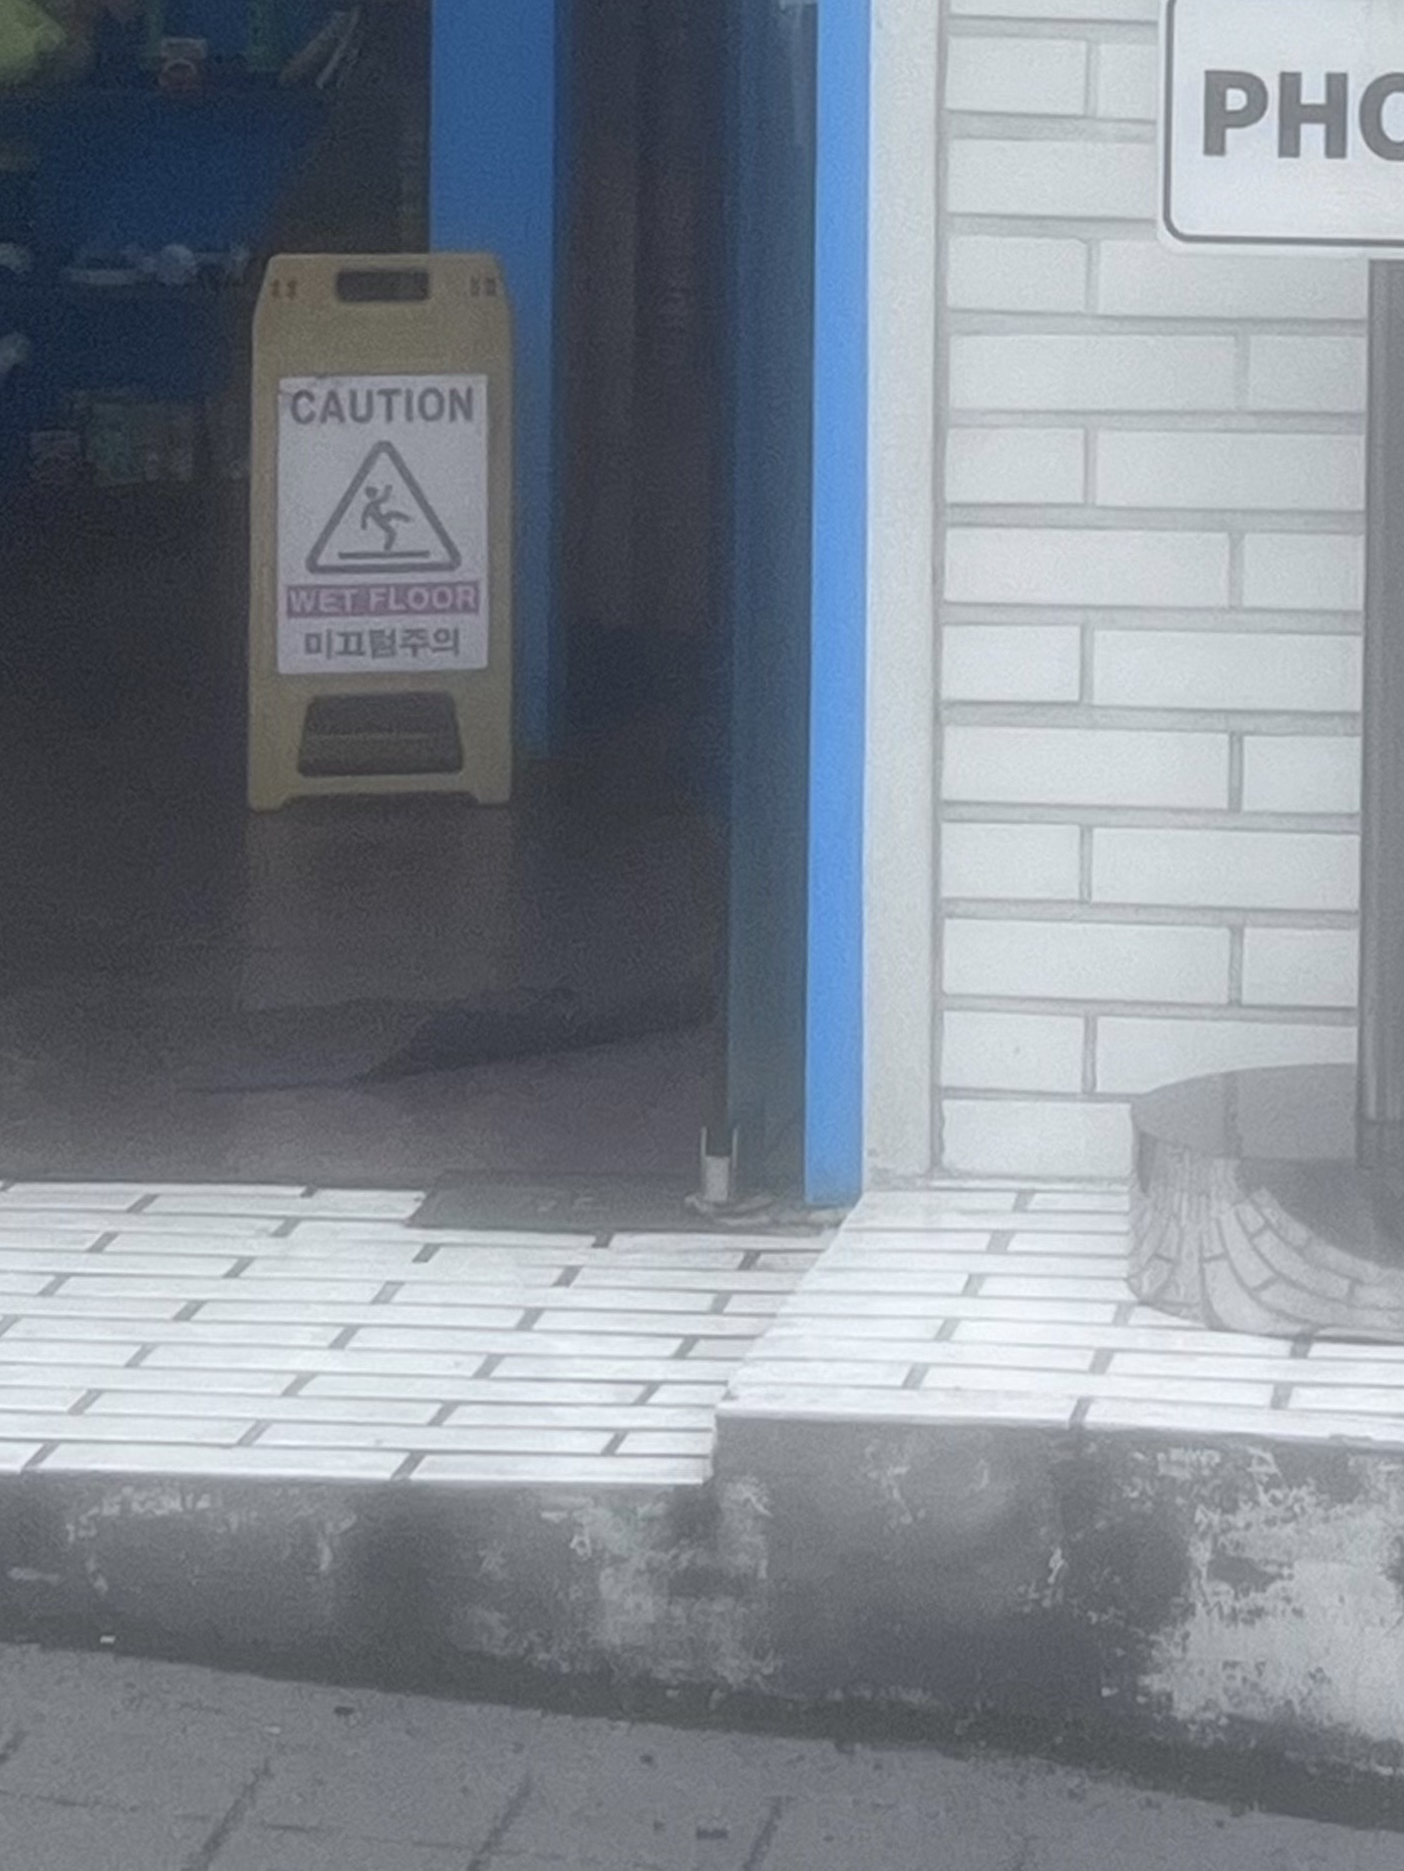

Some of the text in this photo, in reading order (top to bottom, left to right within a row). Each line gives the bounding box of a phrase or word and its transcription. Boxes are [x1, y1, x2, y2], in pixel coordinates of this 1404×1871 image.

[289, 386, 475, 426] CAUTION
[288, 585, 477, 613] WET FLOOR
[304, 628, 460, 660] 미끄럼주의
